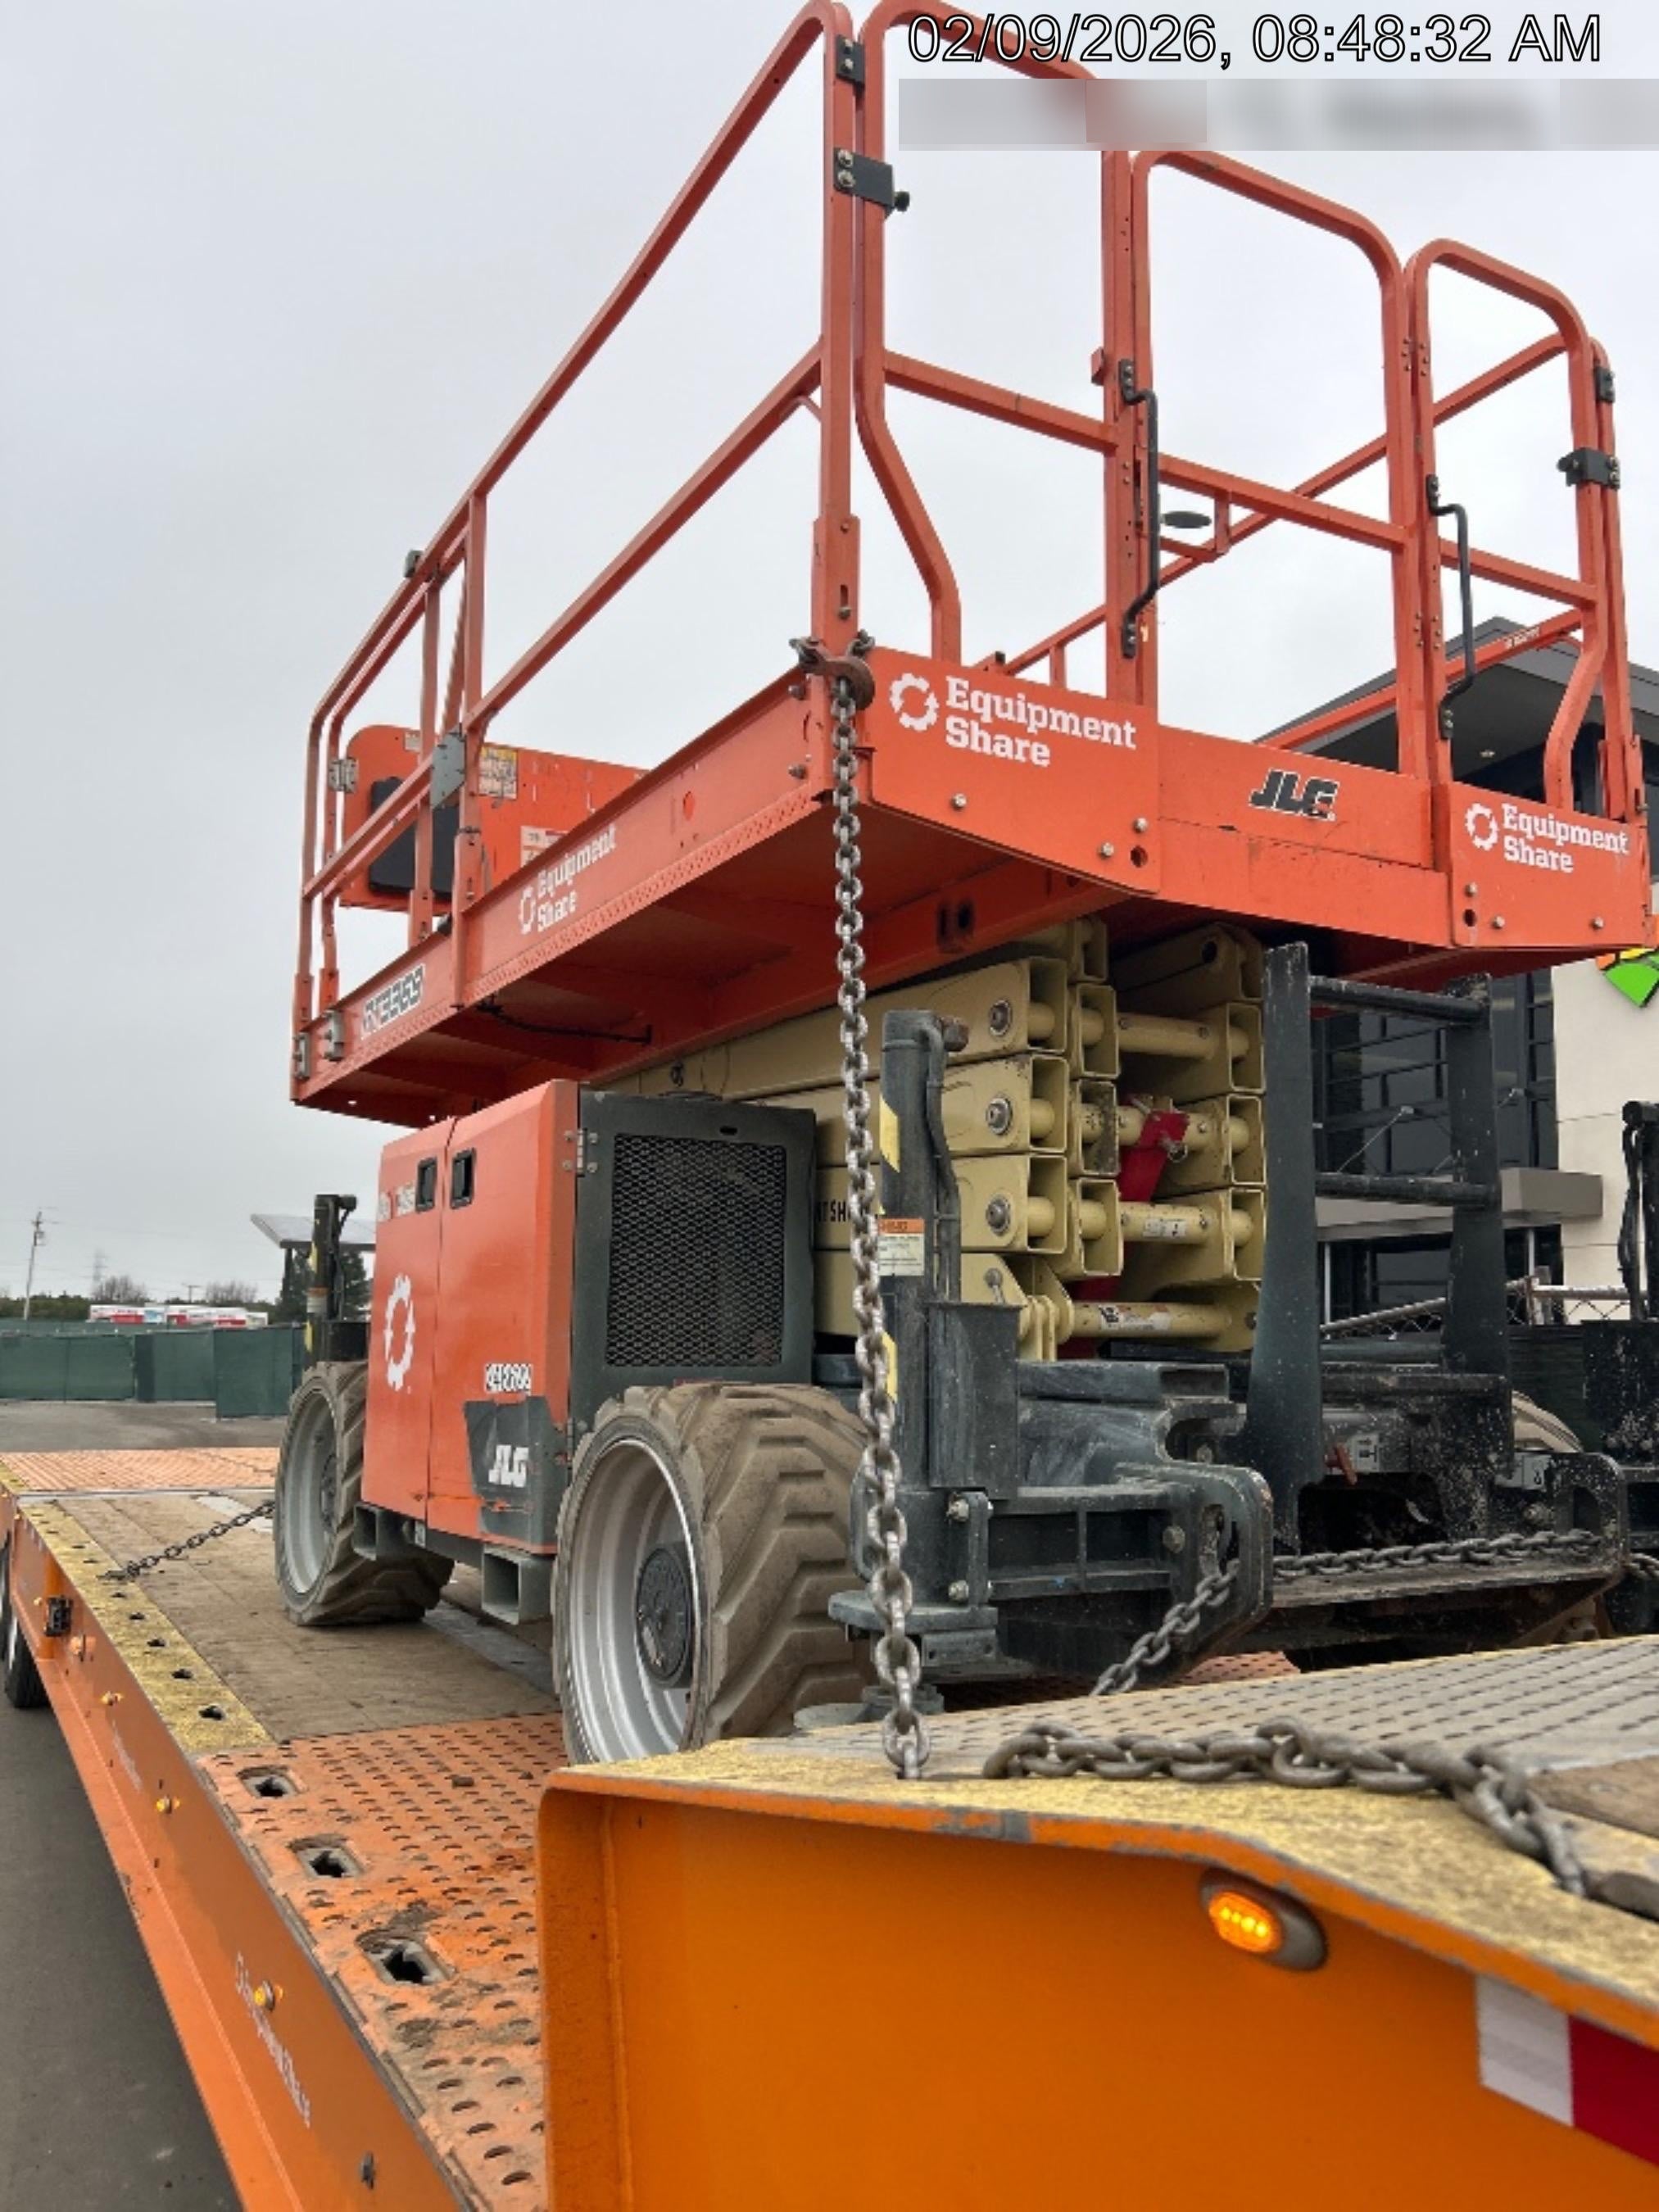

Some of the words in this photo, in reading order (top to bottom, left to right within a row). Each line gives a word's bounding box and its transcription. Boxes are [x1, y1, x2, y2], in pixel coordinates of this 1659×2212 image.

[945, 675, 1137, 750] Equipment
[945, 715, 1050, 767] Share
[1248, 768, 1340, 822] JLG
[1502, 802, 1630, 854] Equipment
[1503, 835, 1574, 873] Share
[537, 823, 615, 899] Equipment
[537, 890, 576, 932] Share
[489, 1444, 528, 1488] JLG
